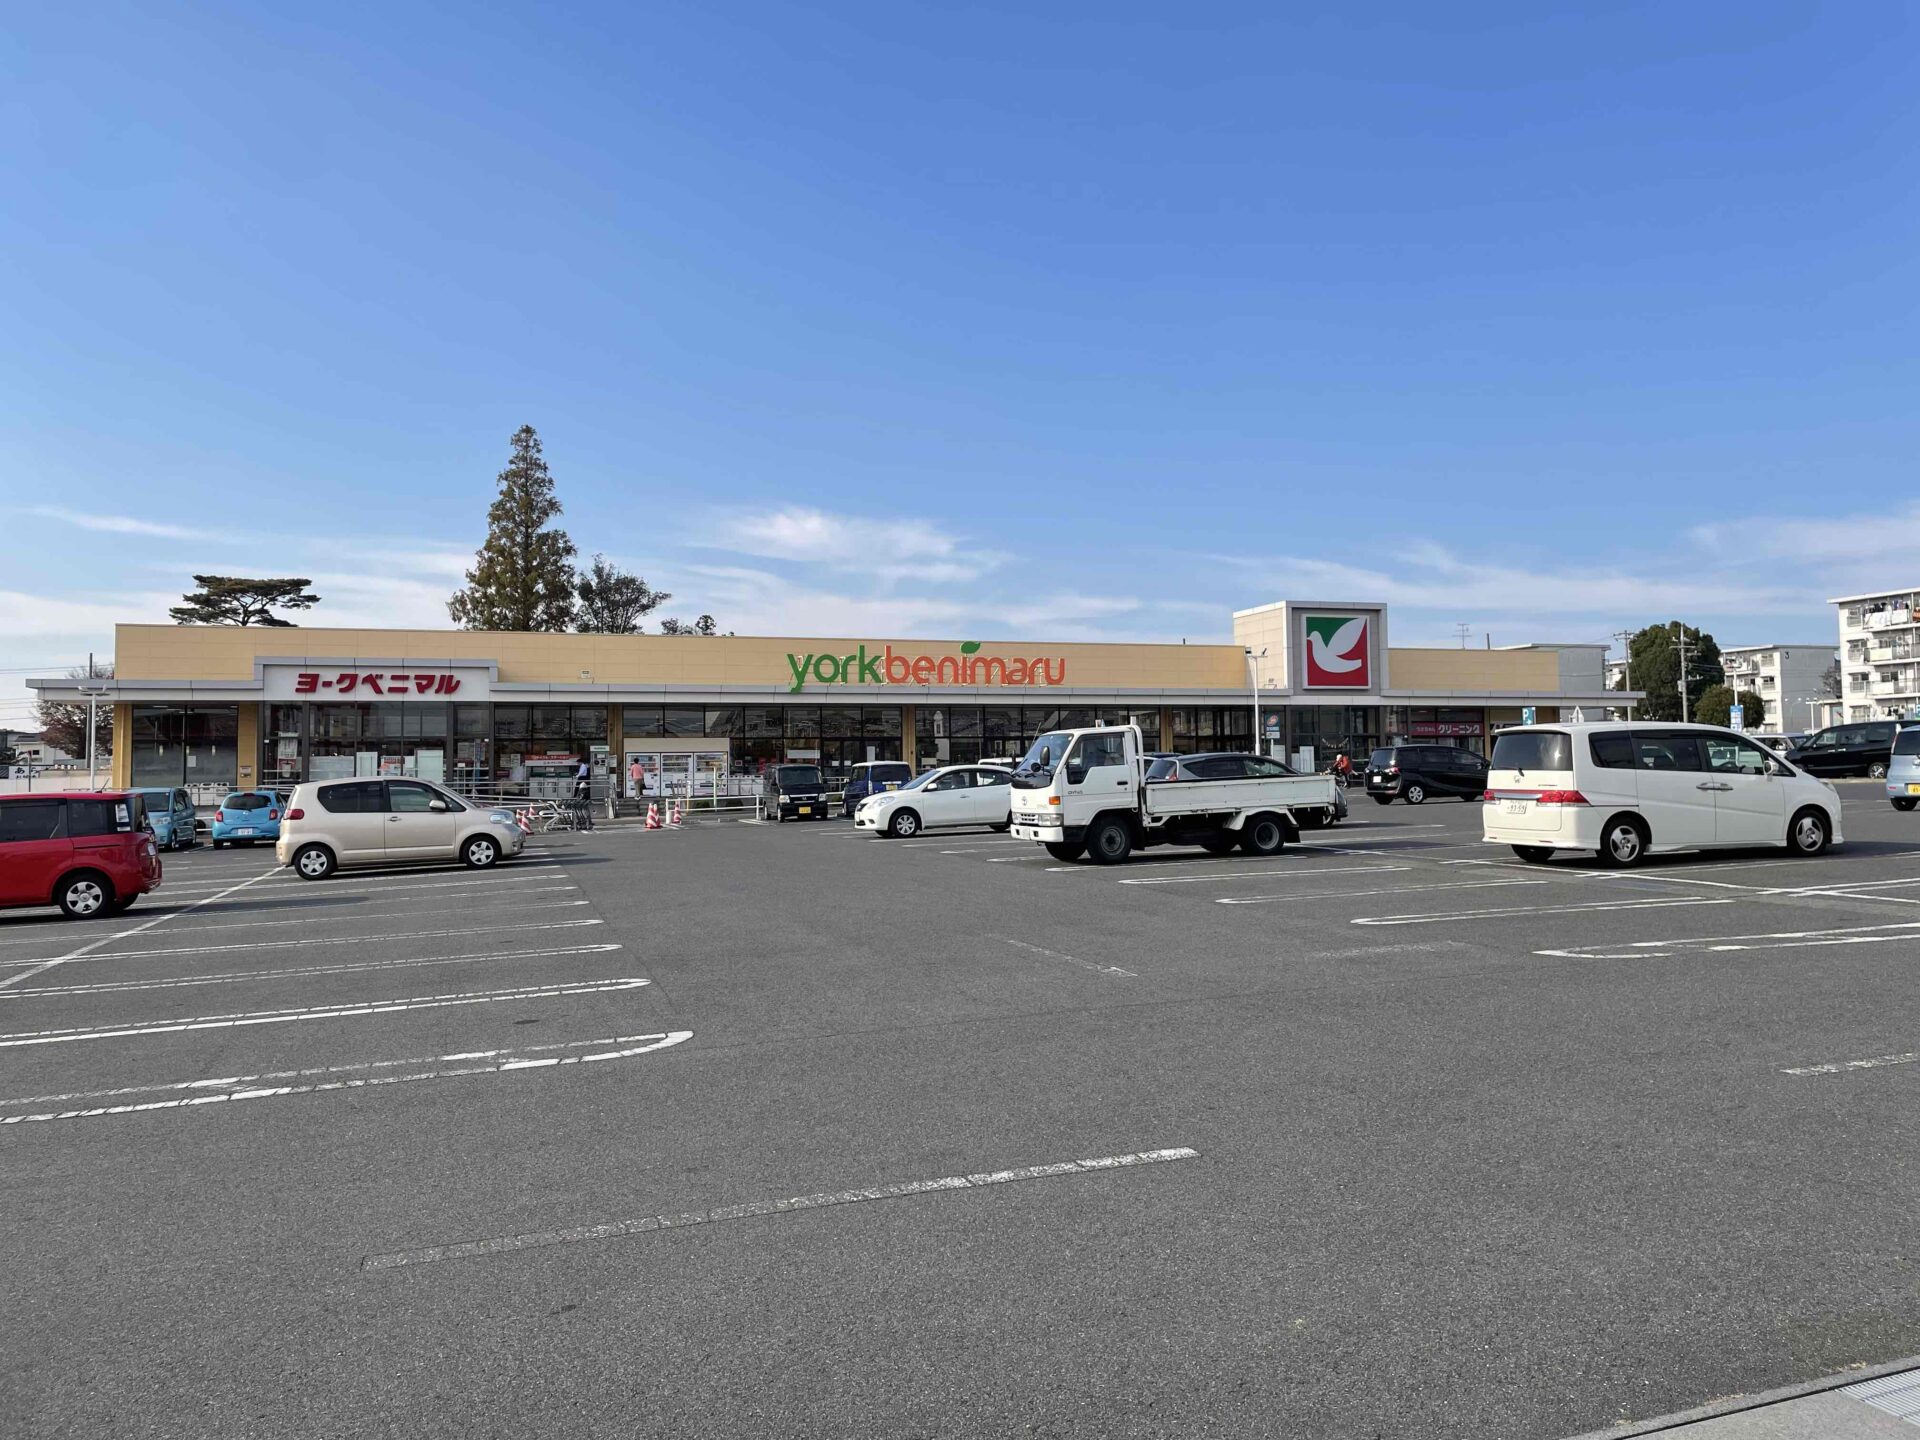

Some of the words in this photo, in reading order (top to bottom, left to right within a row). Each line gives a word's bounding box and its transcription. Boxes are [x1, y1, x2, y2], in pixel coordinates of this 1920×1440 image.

[295, 673, 461, 694] ヨークベニマル
[1522, 708, 1529, 721] P
[1438, 724, 1480, 735] クリーニング
